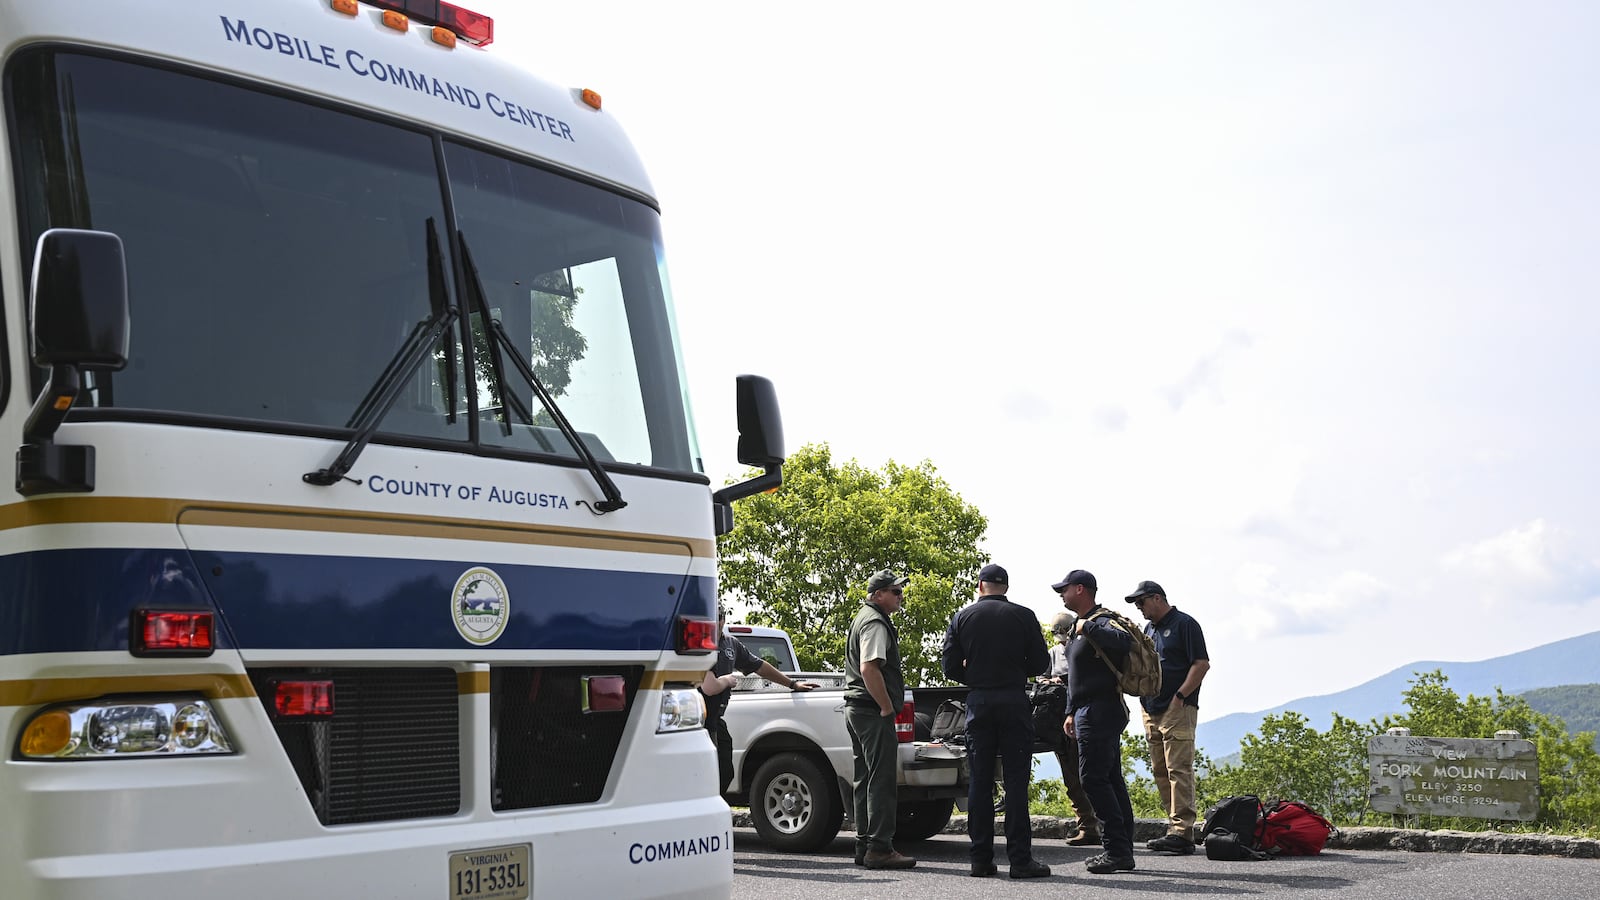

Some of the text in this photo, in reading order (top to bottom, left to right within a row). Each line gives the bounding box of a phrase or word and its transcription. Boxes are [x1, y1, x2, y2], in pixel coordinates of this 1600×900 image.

[220, 15, 575, 142] MOBILE COMMAND CENTER
[368, 475, 568, 509] COUNTY OF AUGUSTA
[1432, 749, 1467, 761] VIEW
[1380, 763, 1527, 780] FORK MOUNTAIN
[1421, 781, 1482, 792] ELEV 3250
[1405, 793, 1499, 805] ELEV HERE 3294
[629, 831, 730, 864] COMMAND 1
[470, 852, 509, 866] VIRGINIA
[456, 863, 525, 895] 131-535L
